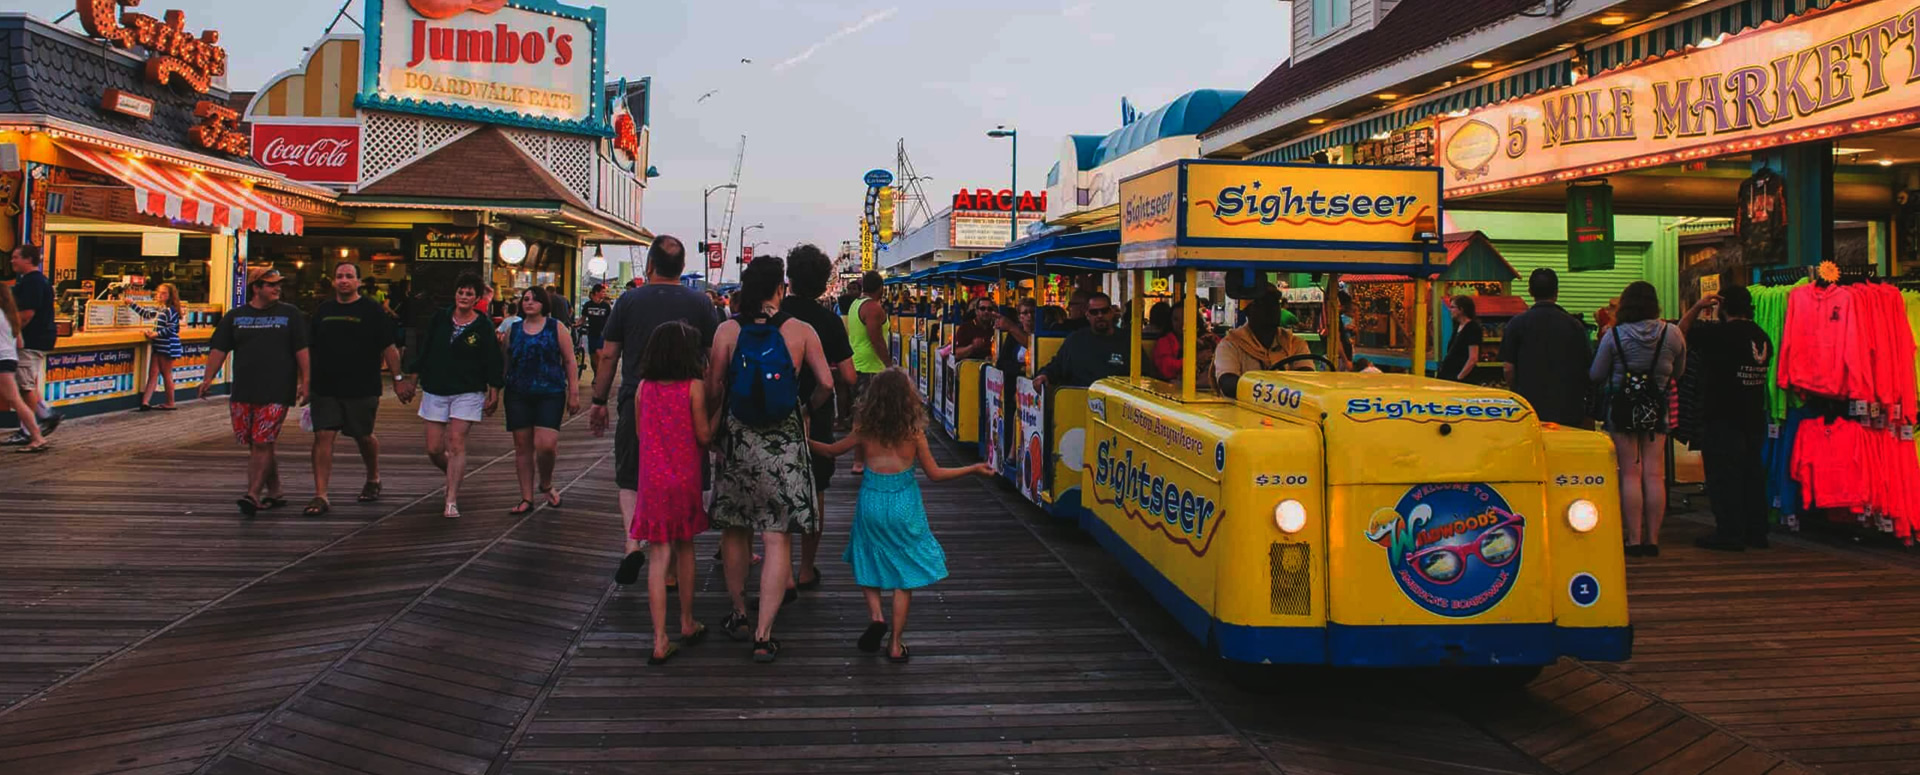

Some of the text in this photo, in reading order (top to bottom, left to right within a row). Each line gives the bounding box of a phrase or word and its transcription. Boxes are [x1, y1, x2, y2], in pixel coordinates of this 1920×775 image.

[406, 19, 573, 68] Jumbo's
[404, 72, 572, 109] BOARDWALK EATS
[1505, 115, 1527, 159] 5
[1541, 86, 1637, 149] MILE
[262, 137, 354, 167] Coca-Cola
[1125, 191, 1173, 226] Sightseer
[1214, 179, 1416, 225] Sightseer
[419, 243, 475, 259] EATERY
[56, 269, 76, 279] HOT
[1252, 380, 1301, 409] $3.00
[1347, 398, 1521, 418] Sightseer
[1134, 408, 1152, 431] Stop
[1154, 417, 1203, 455] Anywhere
[1095, 435, 1214, 538] Sightseer
[1256, 474, 1307, 486] $3.00
[1411, 483, 1490, 501] WELCOME TO
[1556, 475, 1605, 486] $3.00
[1398, 569, 1510, 609] AMERICA'S BOARDWALK
[1579, 584, 1590, 594] 1
